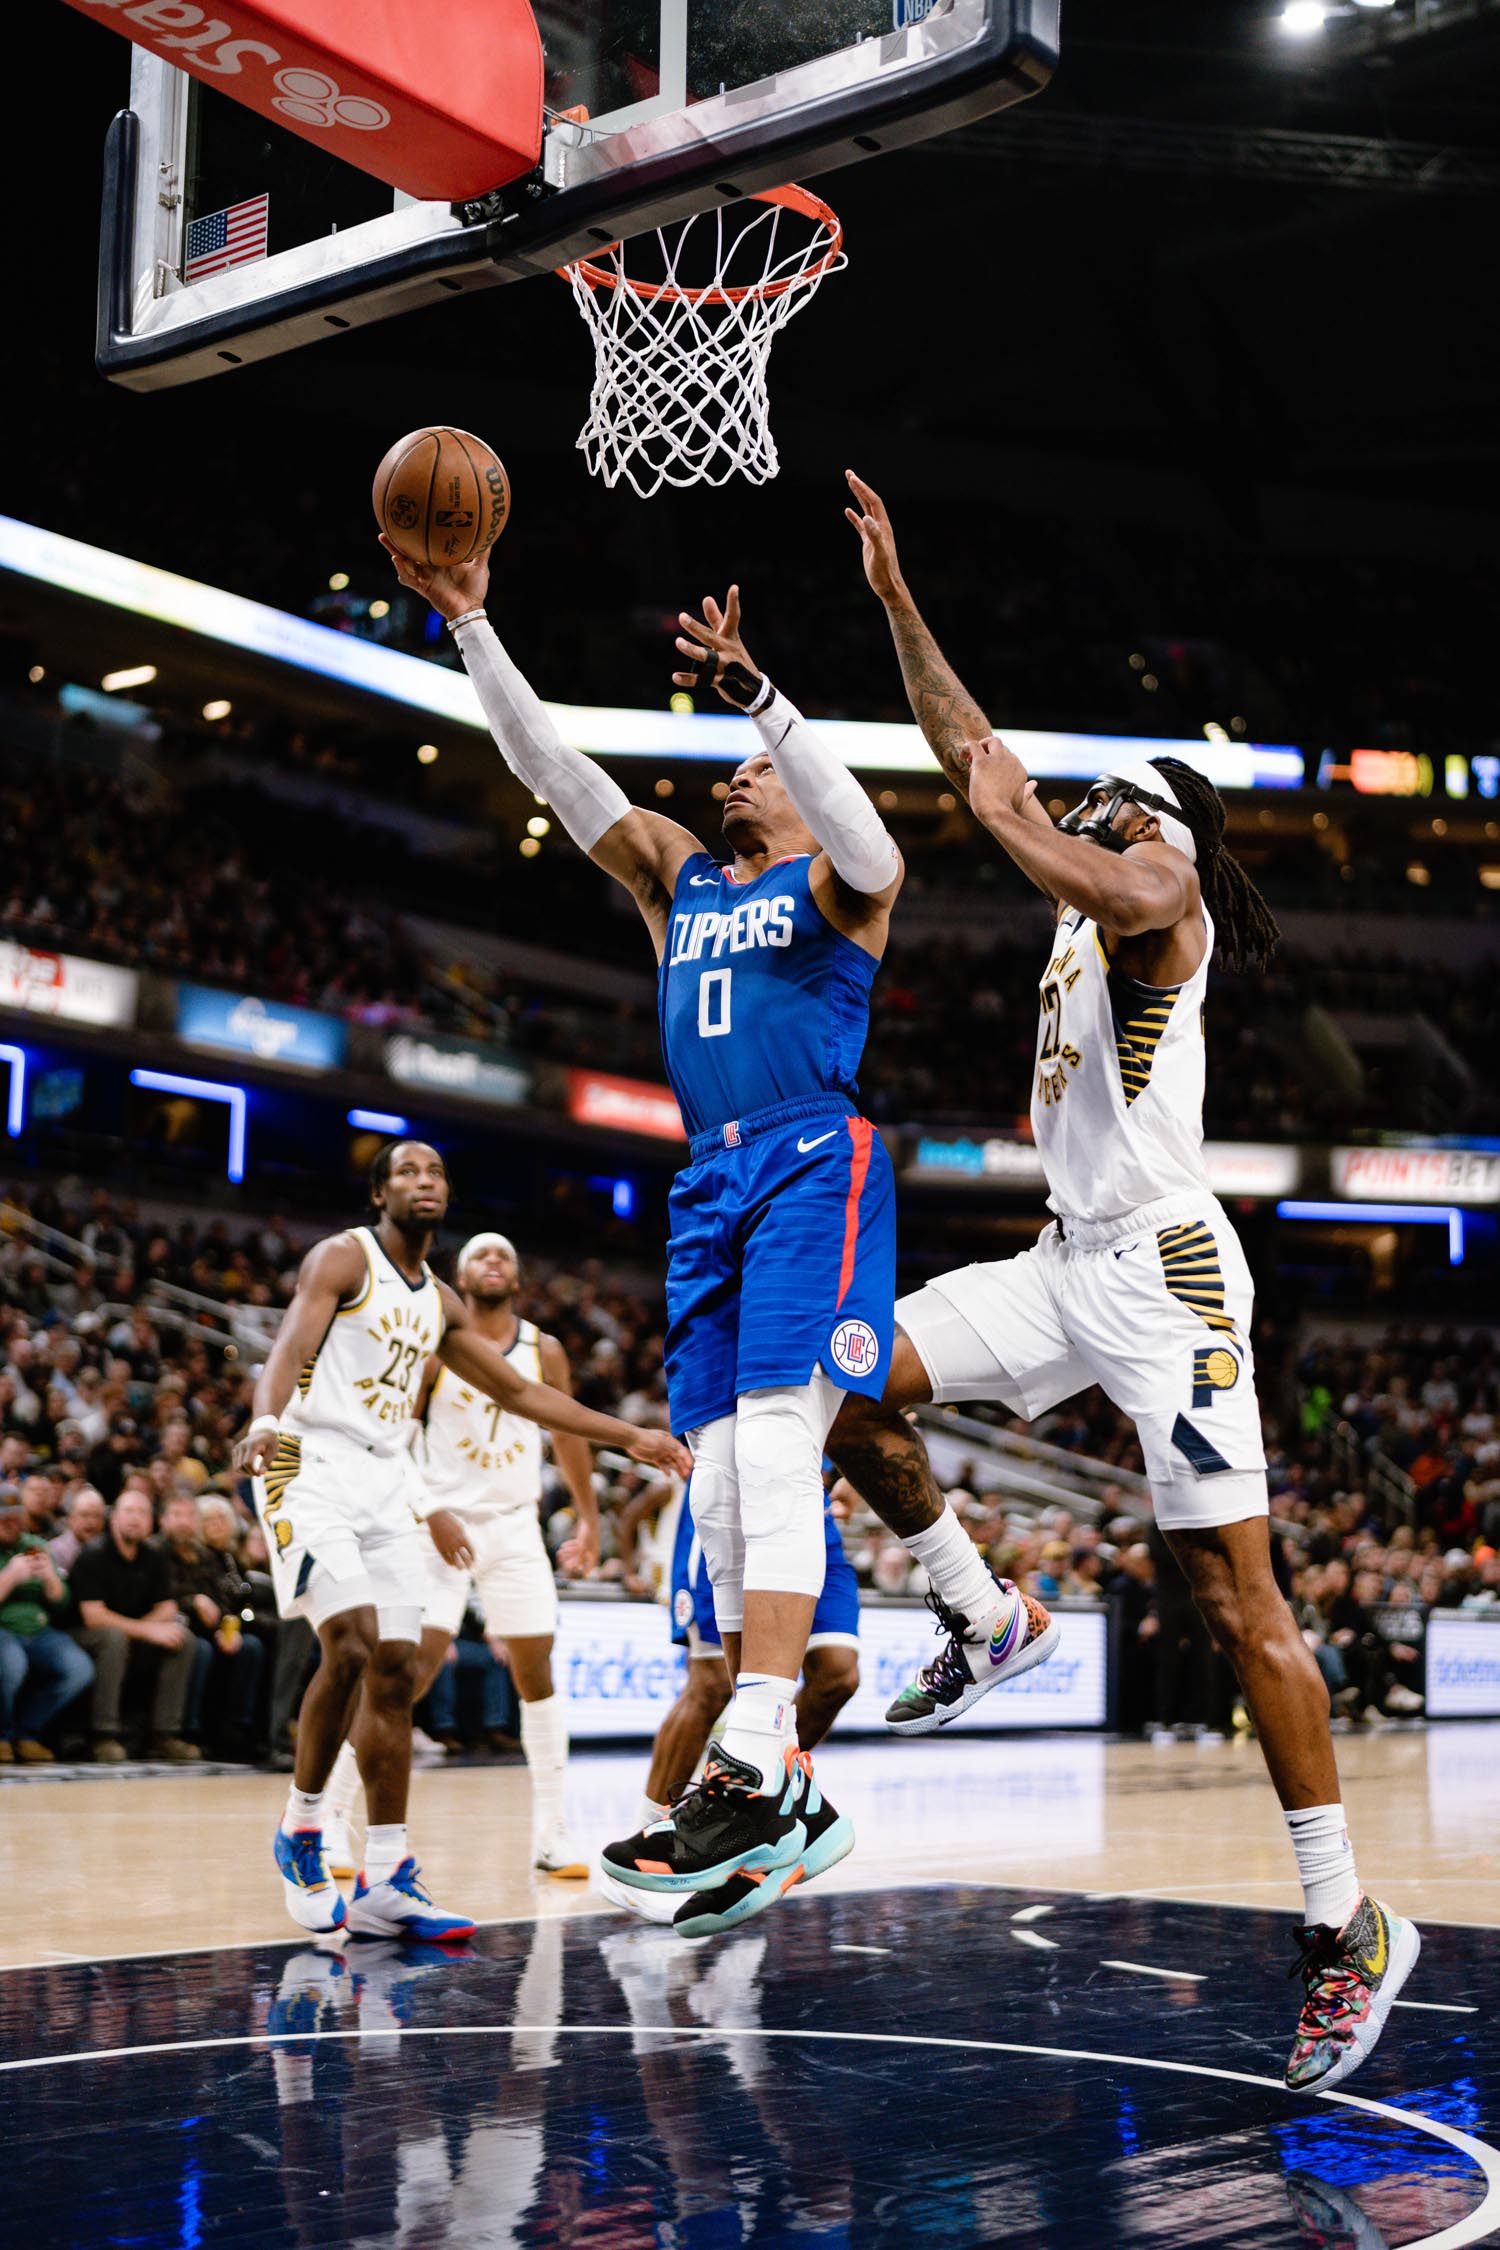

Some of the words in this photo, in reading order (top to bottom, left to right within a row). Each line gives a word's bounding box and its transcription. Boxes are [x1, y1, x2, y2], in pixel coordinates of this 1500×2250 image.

[669, 896, 795, 966] CLIPPERS
[698, 967, 732, 1038] 0
[378, 1336, 419, 1393] 23
[484, 1402, 501, 1443] 7
